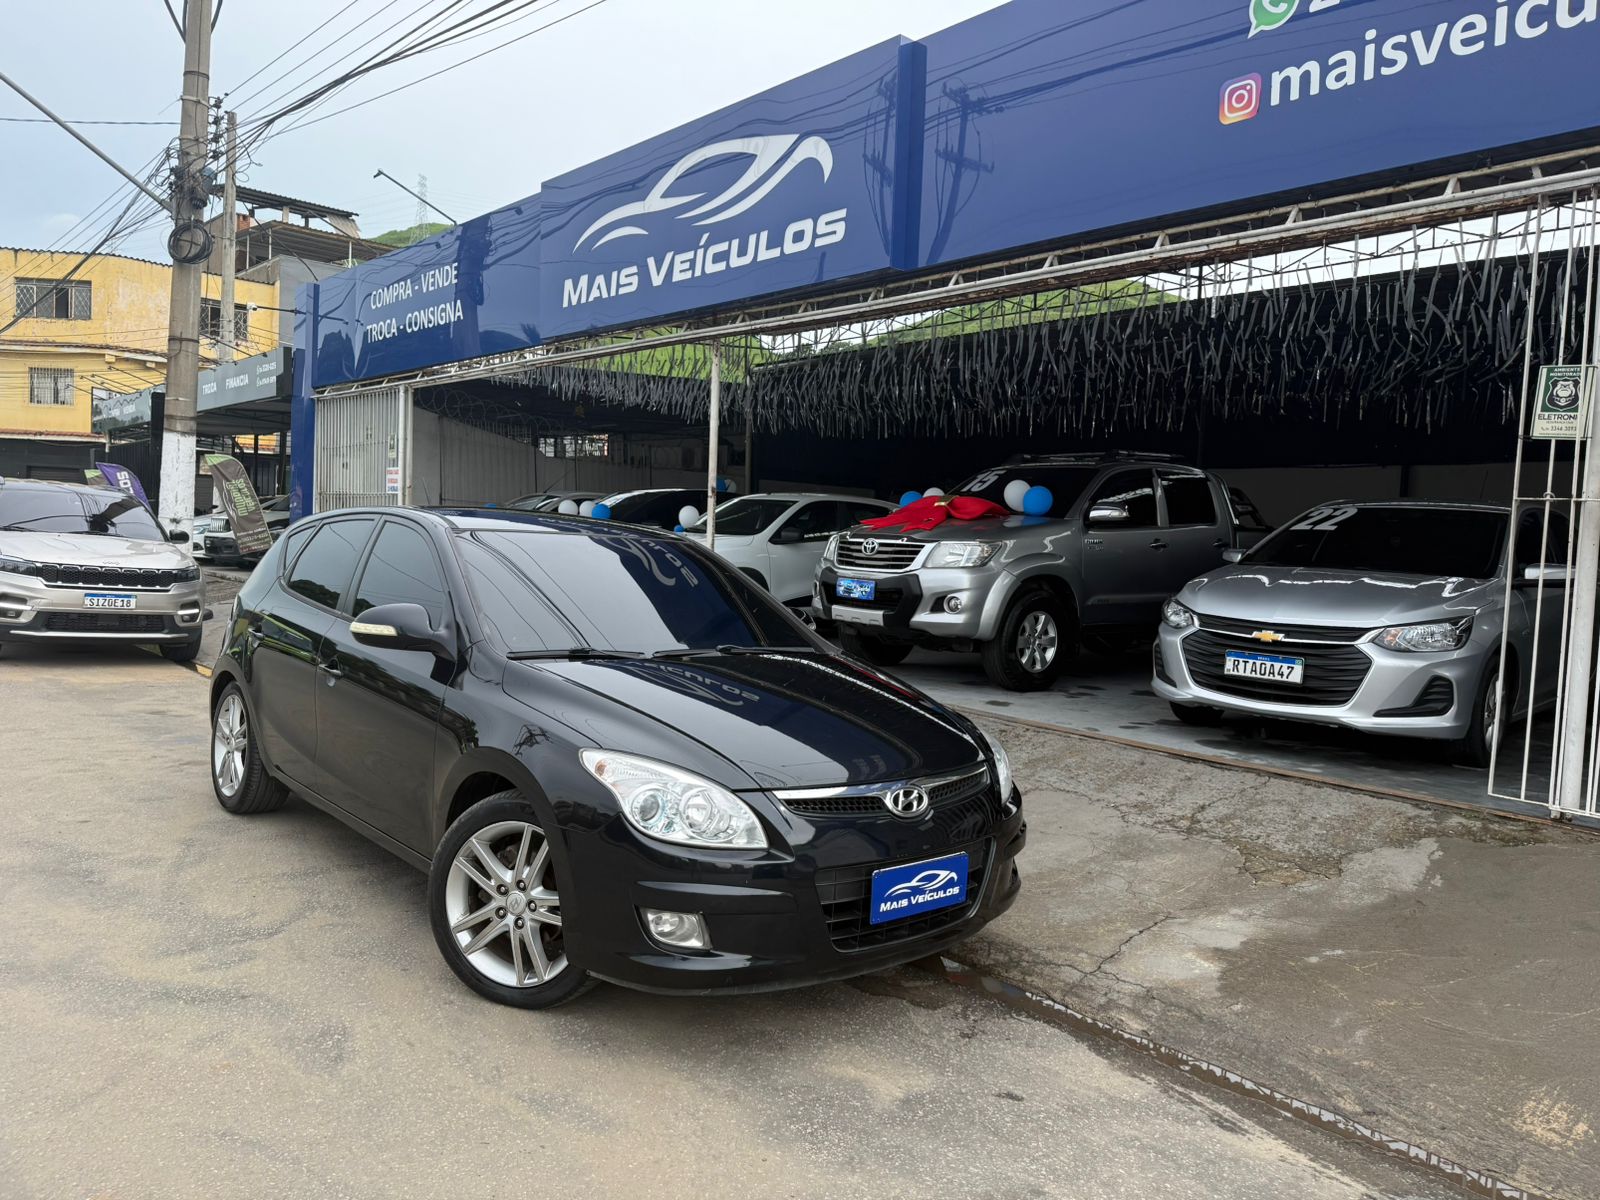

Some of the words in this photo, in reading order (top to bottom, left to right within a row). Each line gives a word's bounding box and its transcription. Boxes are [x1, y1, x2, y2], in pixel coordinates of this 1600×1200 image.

[562, 265, 640, 308] MAIS
[647, 208, 848, 287] VEÍCULOS
[370, 279, 413, 310] COMPRA
[421, 262, 458, 293] VENDE
[366, 317, 398, 344] TROCA
[405, 299, 464, 334] CONSIGNA
[960, 470, 1008, 492] 15
[1289, 507, 1359, 531] 22
[880, 898, 909, 913] MAIS
[910, 886, 960, 905] VEÍCULOS
